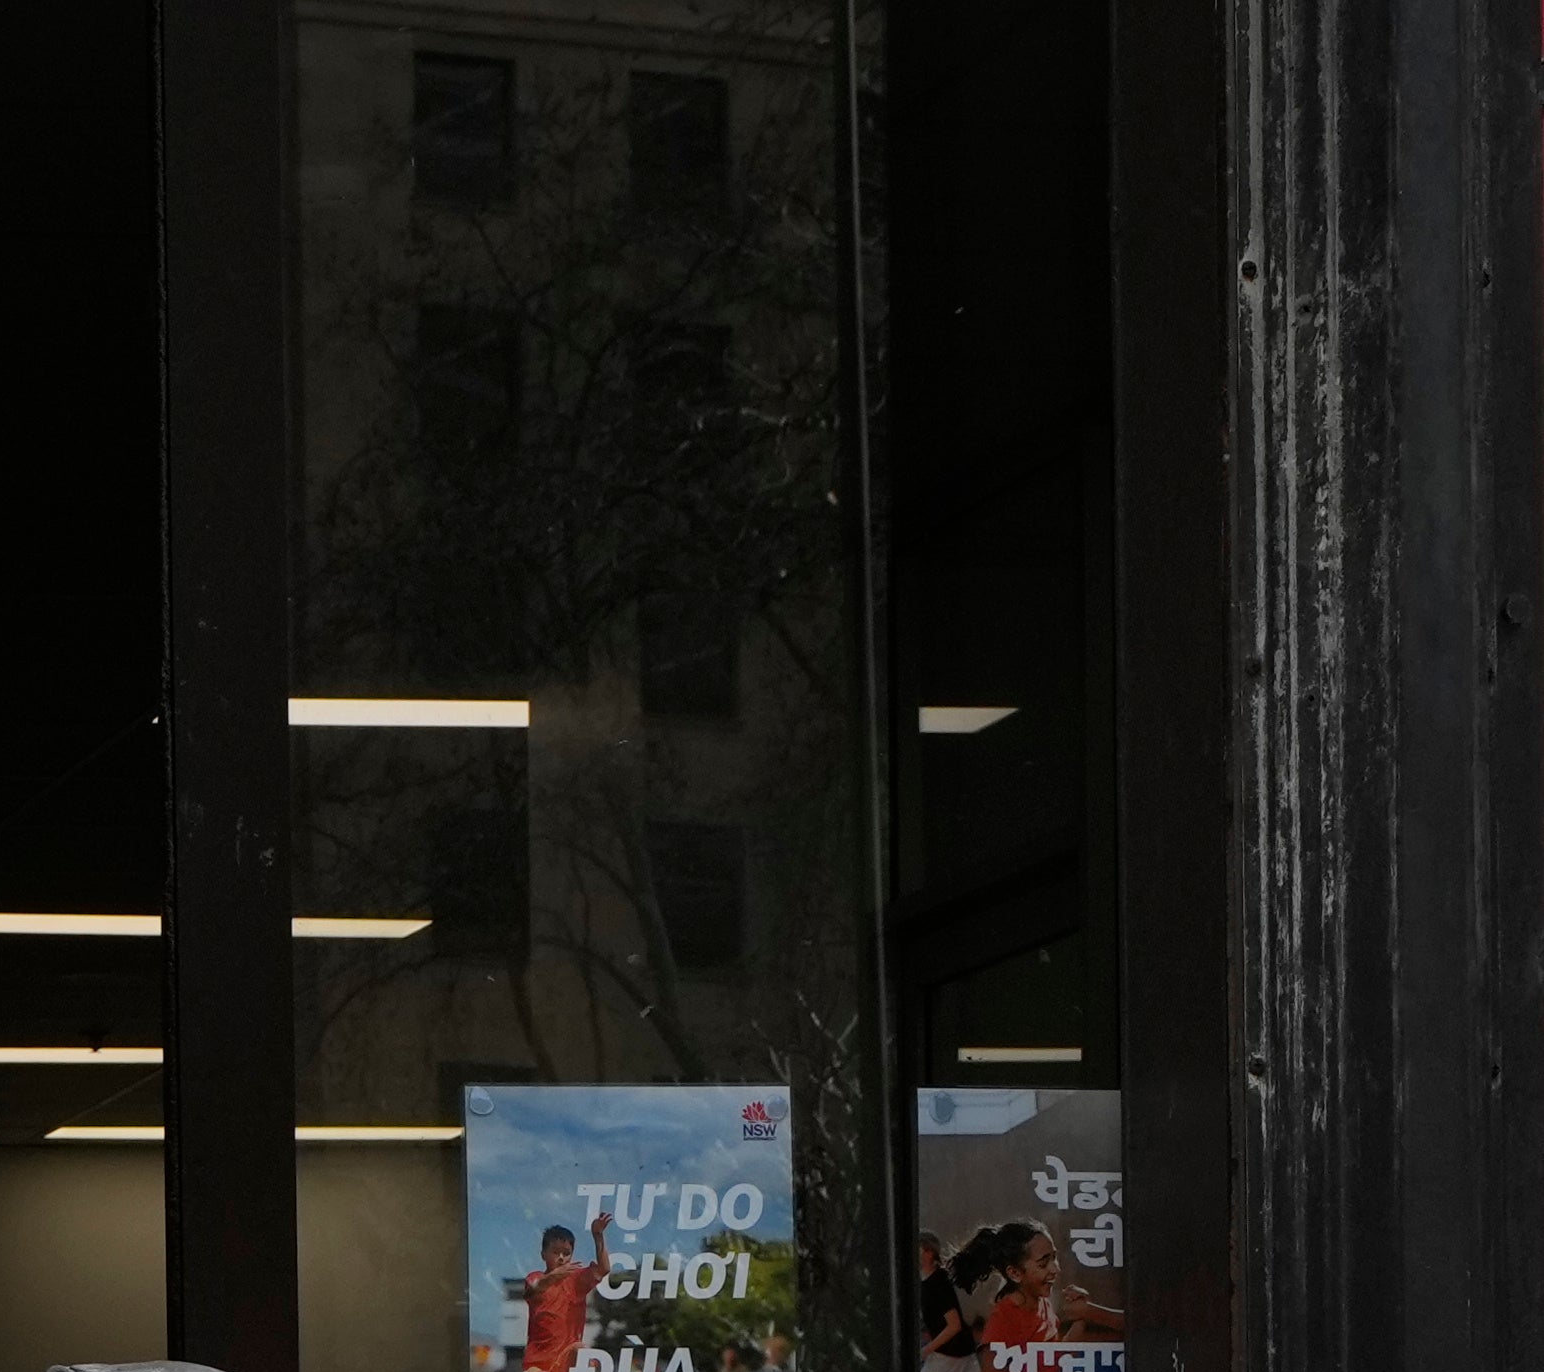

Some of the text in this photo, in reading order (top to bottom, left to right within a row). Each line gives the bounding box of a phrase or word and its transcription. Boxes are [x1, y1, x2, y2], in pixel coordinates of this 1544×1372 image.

[743, 1124, 777, 1136] NSW
[577, 1183, 763, 1243] TỰ DO
[595, 1251, 751, 1300] CHƠI
